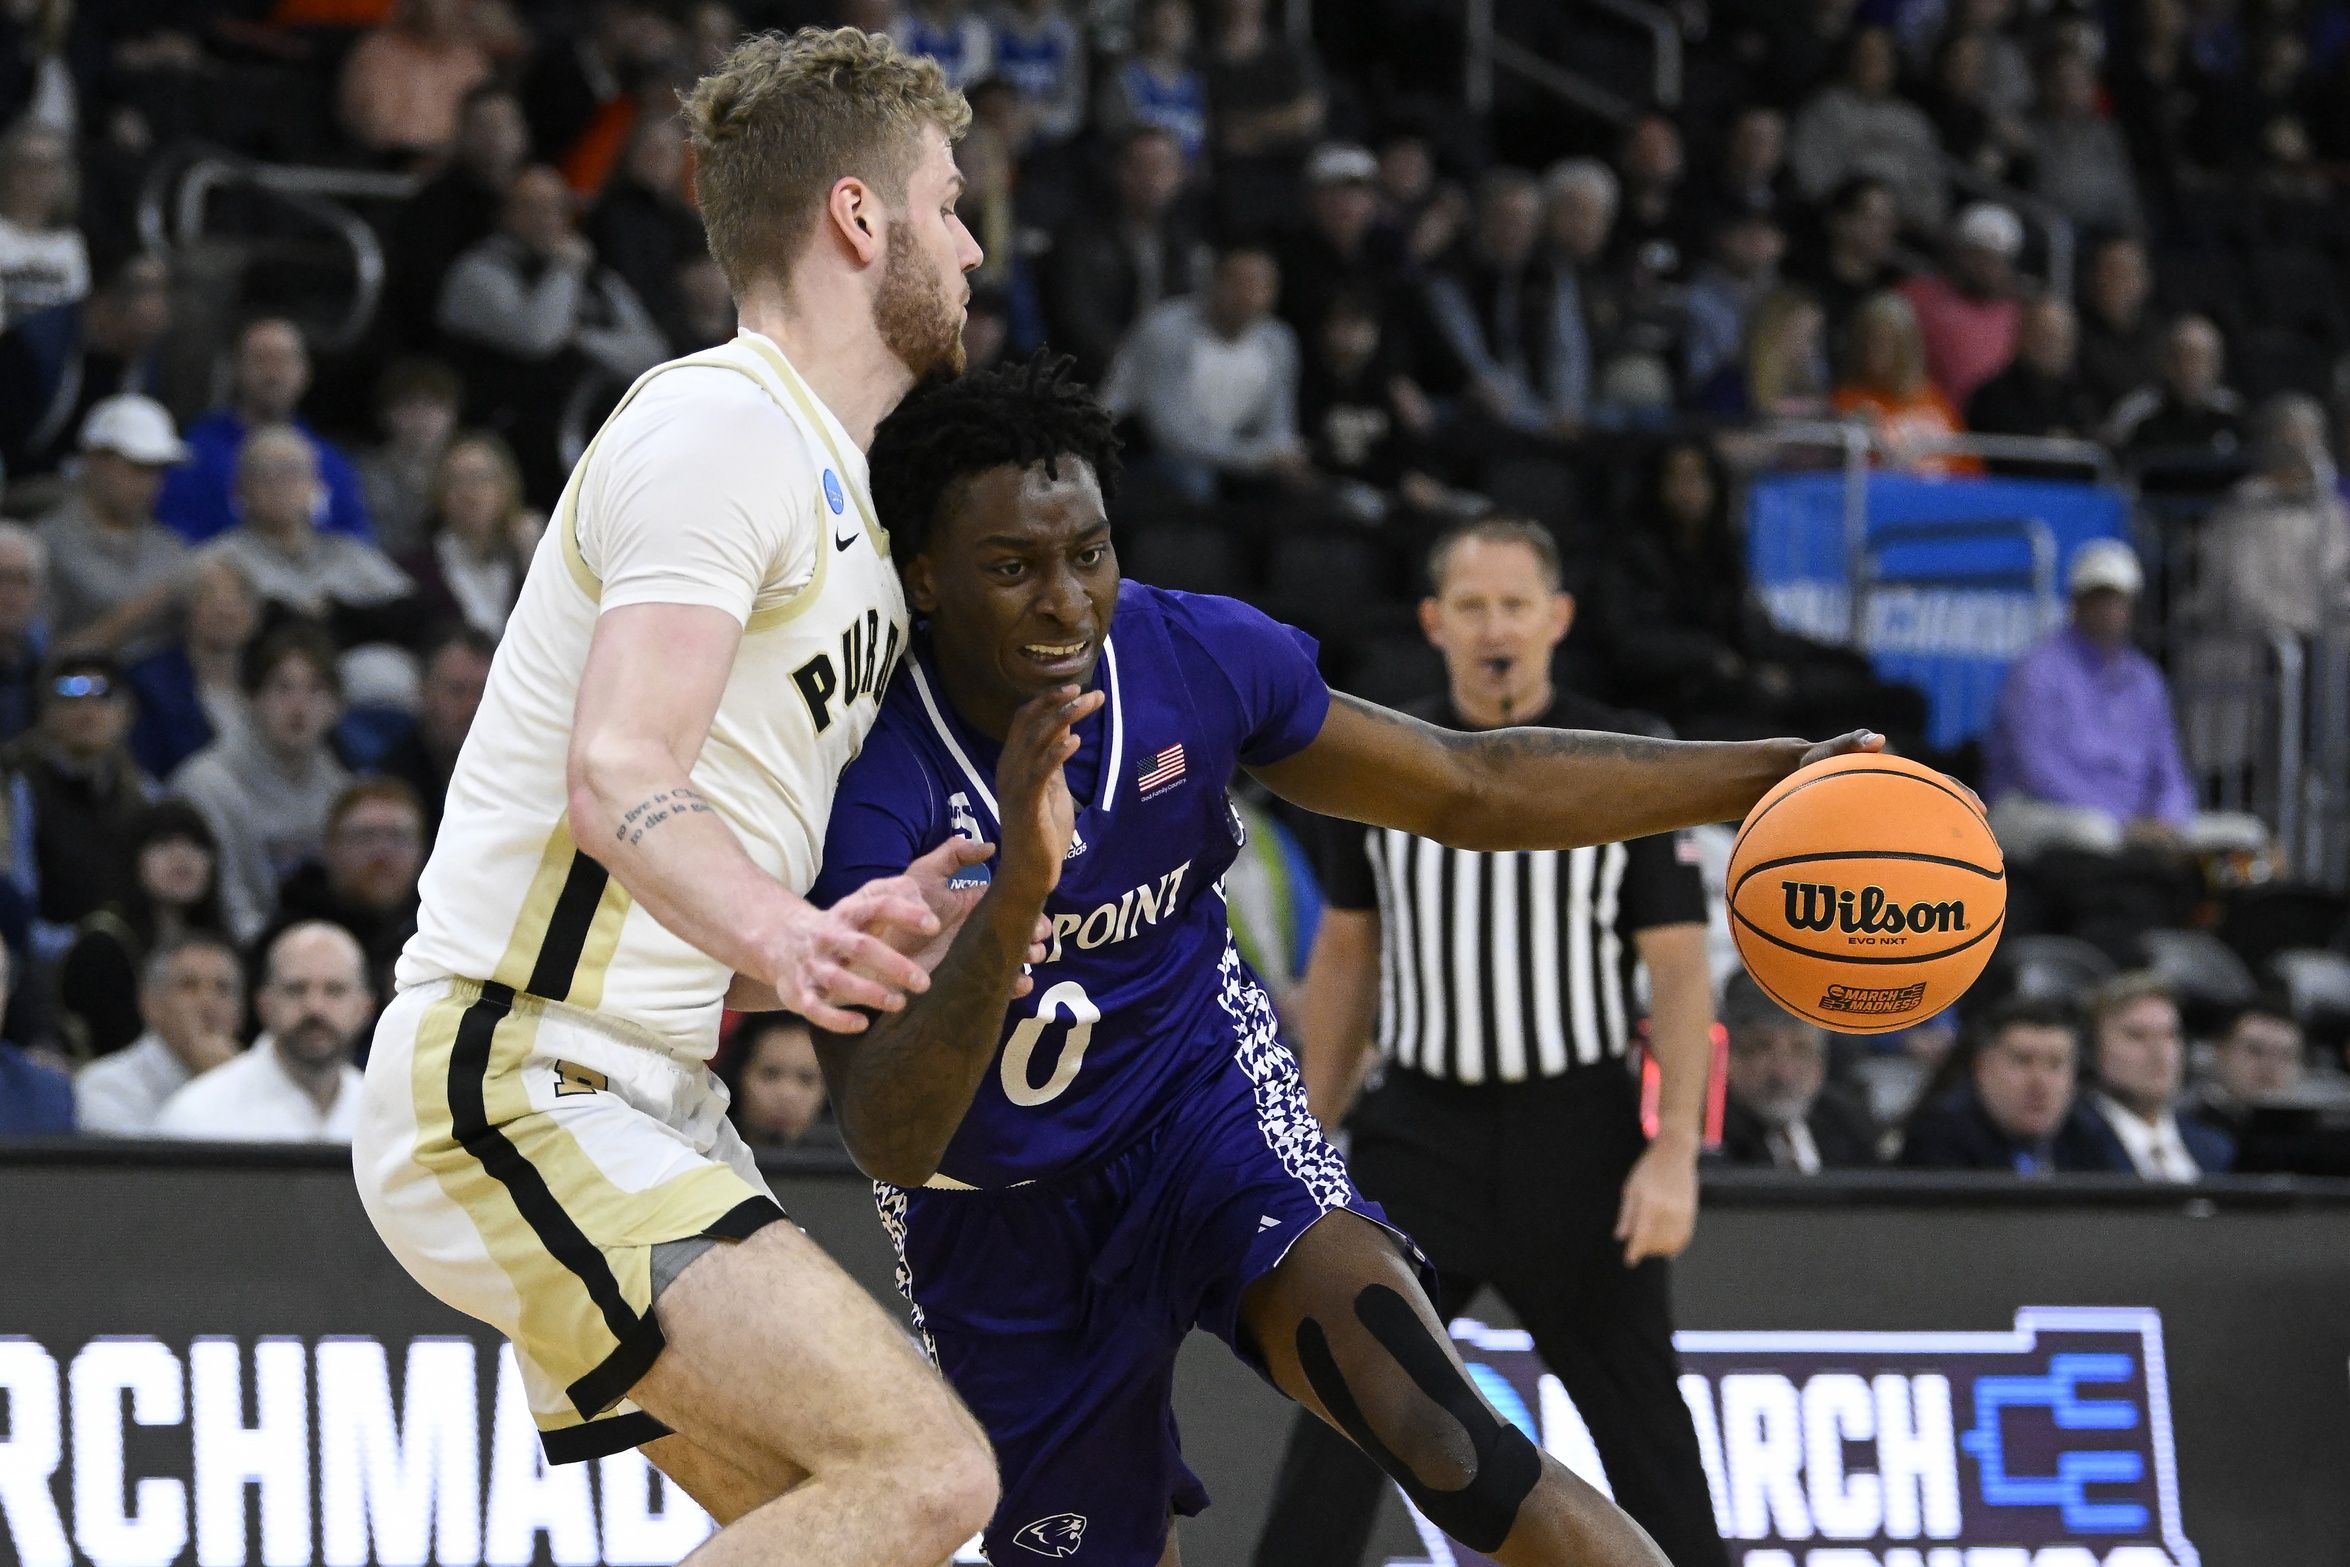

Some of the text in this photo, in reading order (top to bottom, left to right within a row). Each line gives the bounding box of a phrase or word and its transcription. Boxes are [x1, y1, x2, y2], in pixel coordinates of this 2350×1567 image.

[1046, 859, 1192, 963] POINT
[1781, 880, 1966, 934] Wilson
[1848, 937, 1908, 945] EVO NXT
[1844, 989, 1899, 1002] MARCH
[1849, 998, 1921, 1011] MADNESS
[1000, 981, 1102, 1107] 0
